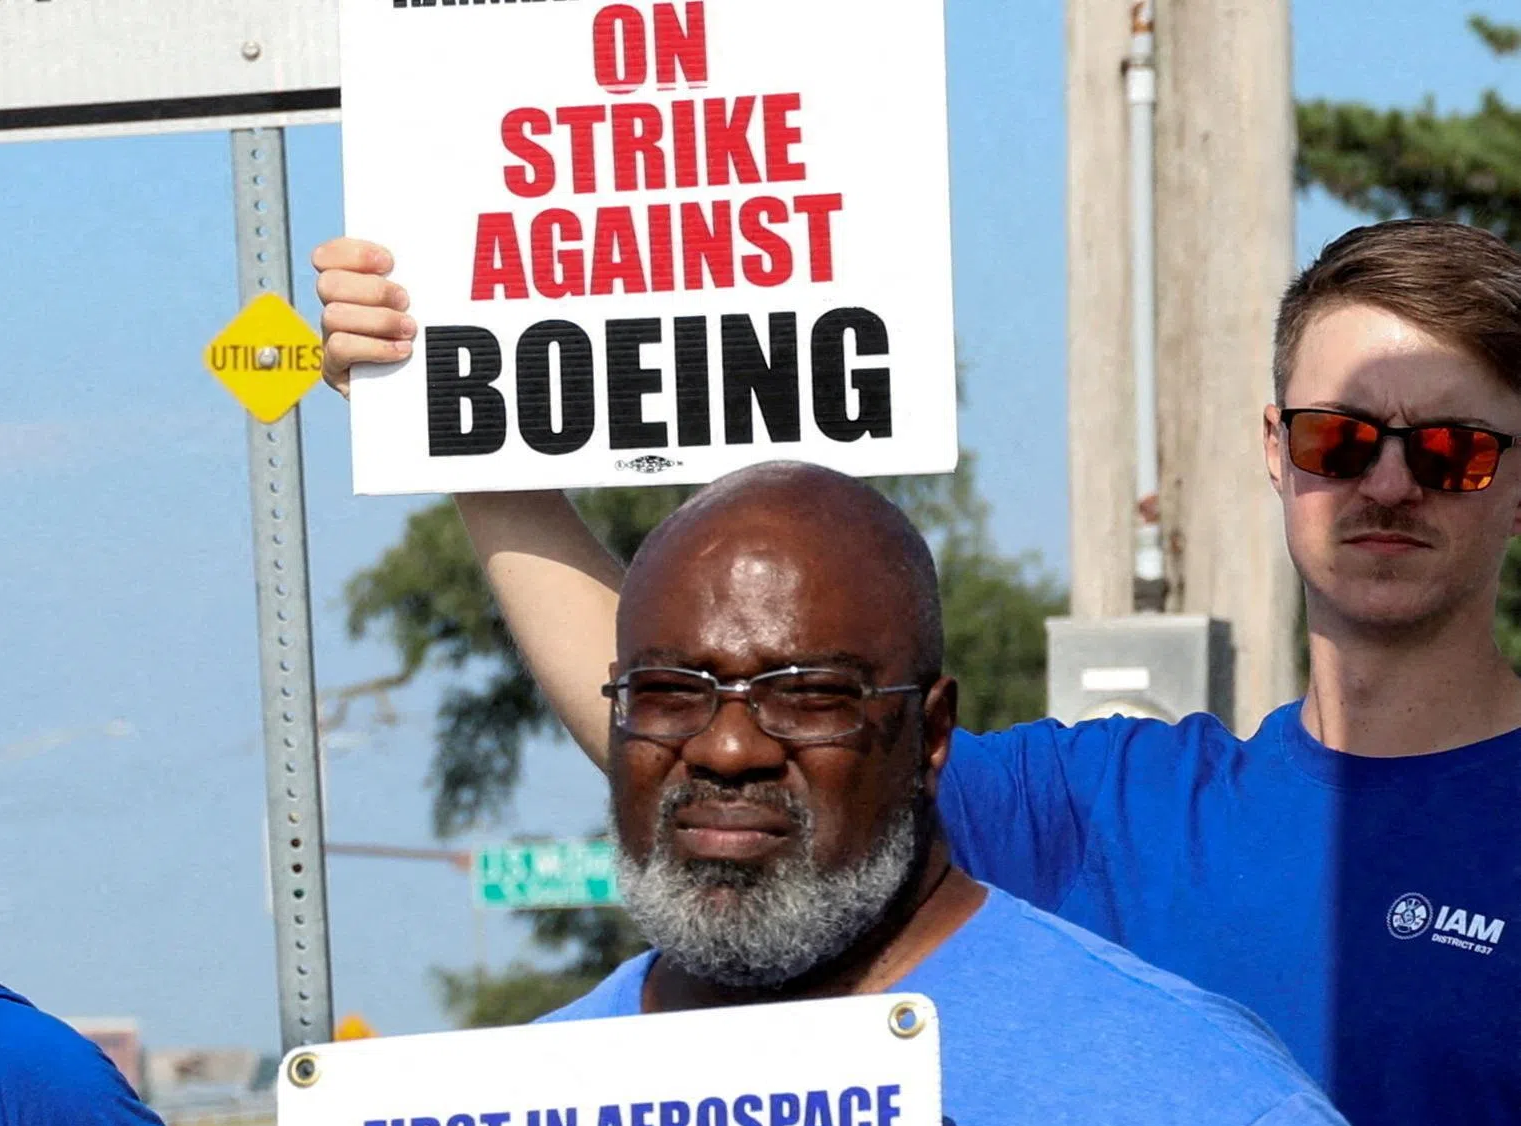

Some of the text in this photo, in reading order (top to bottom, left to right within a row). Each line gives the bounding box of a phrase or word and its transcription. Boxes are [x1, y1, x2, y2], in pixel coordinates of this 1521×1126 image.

[593, 1, 708, 94] ON
[502, 93, 806, 198] STRIKE
[471, 193, 842, 300] AGAINST
[210, 344, 324, 371] UTILTIES
[425, 307, 892, 456] BOEING
[1431, 933, 1475, 951] DISTRICT
[1434, 905, 1505, 944] IAM
